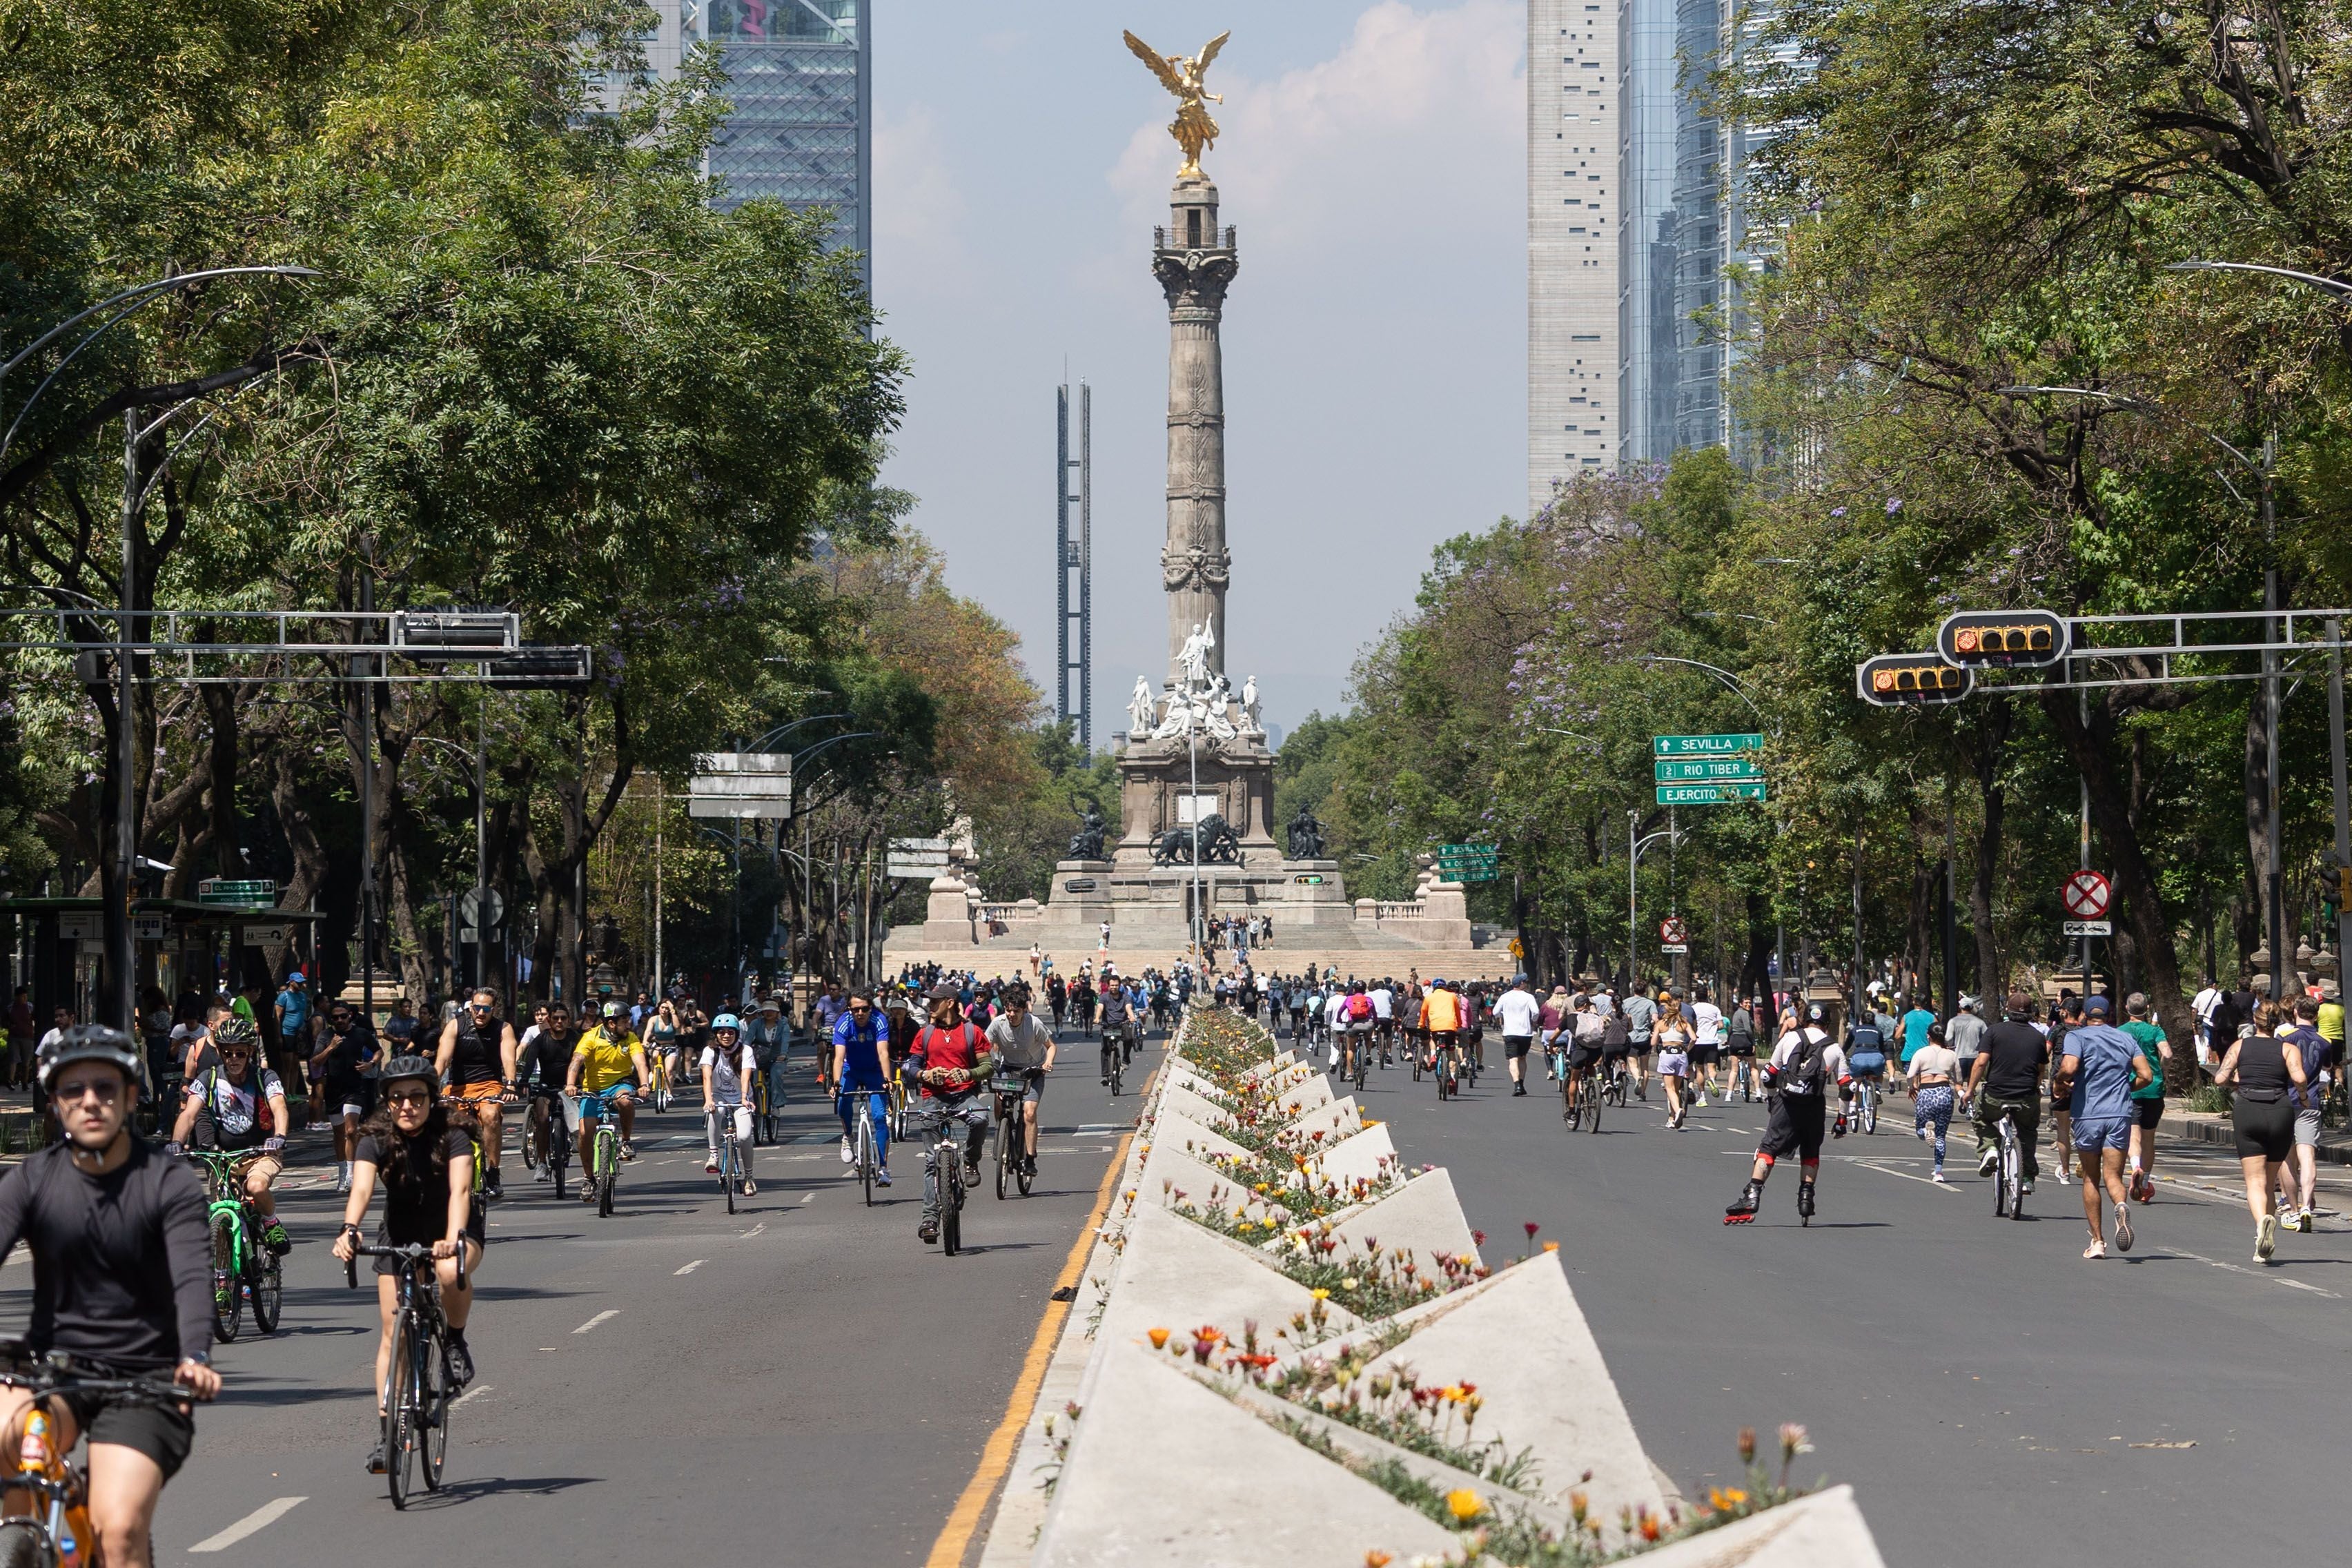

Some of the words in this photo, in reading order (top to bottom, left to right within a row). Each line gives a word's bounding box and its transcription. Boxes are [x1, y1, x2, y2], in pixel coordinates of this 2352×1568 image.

[1680, 738, 1733, 750] SEVILLA
[1666, 767, 1672, 775] 2
[1684, 765, 1703, 776] RIO
[1709, 763, 1741, 775] TIBER
[1666, 789, 1717, 801] EJERCITO
[1454, 859, 1484, 867] OCAMPO
